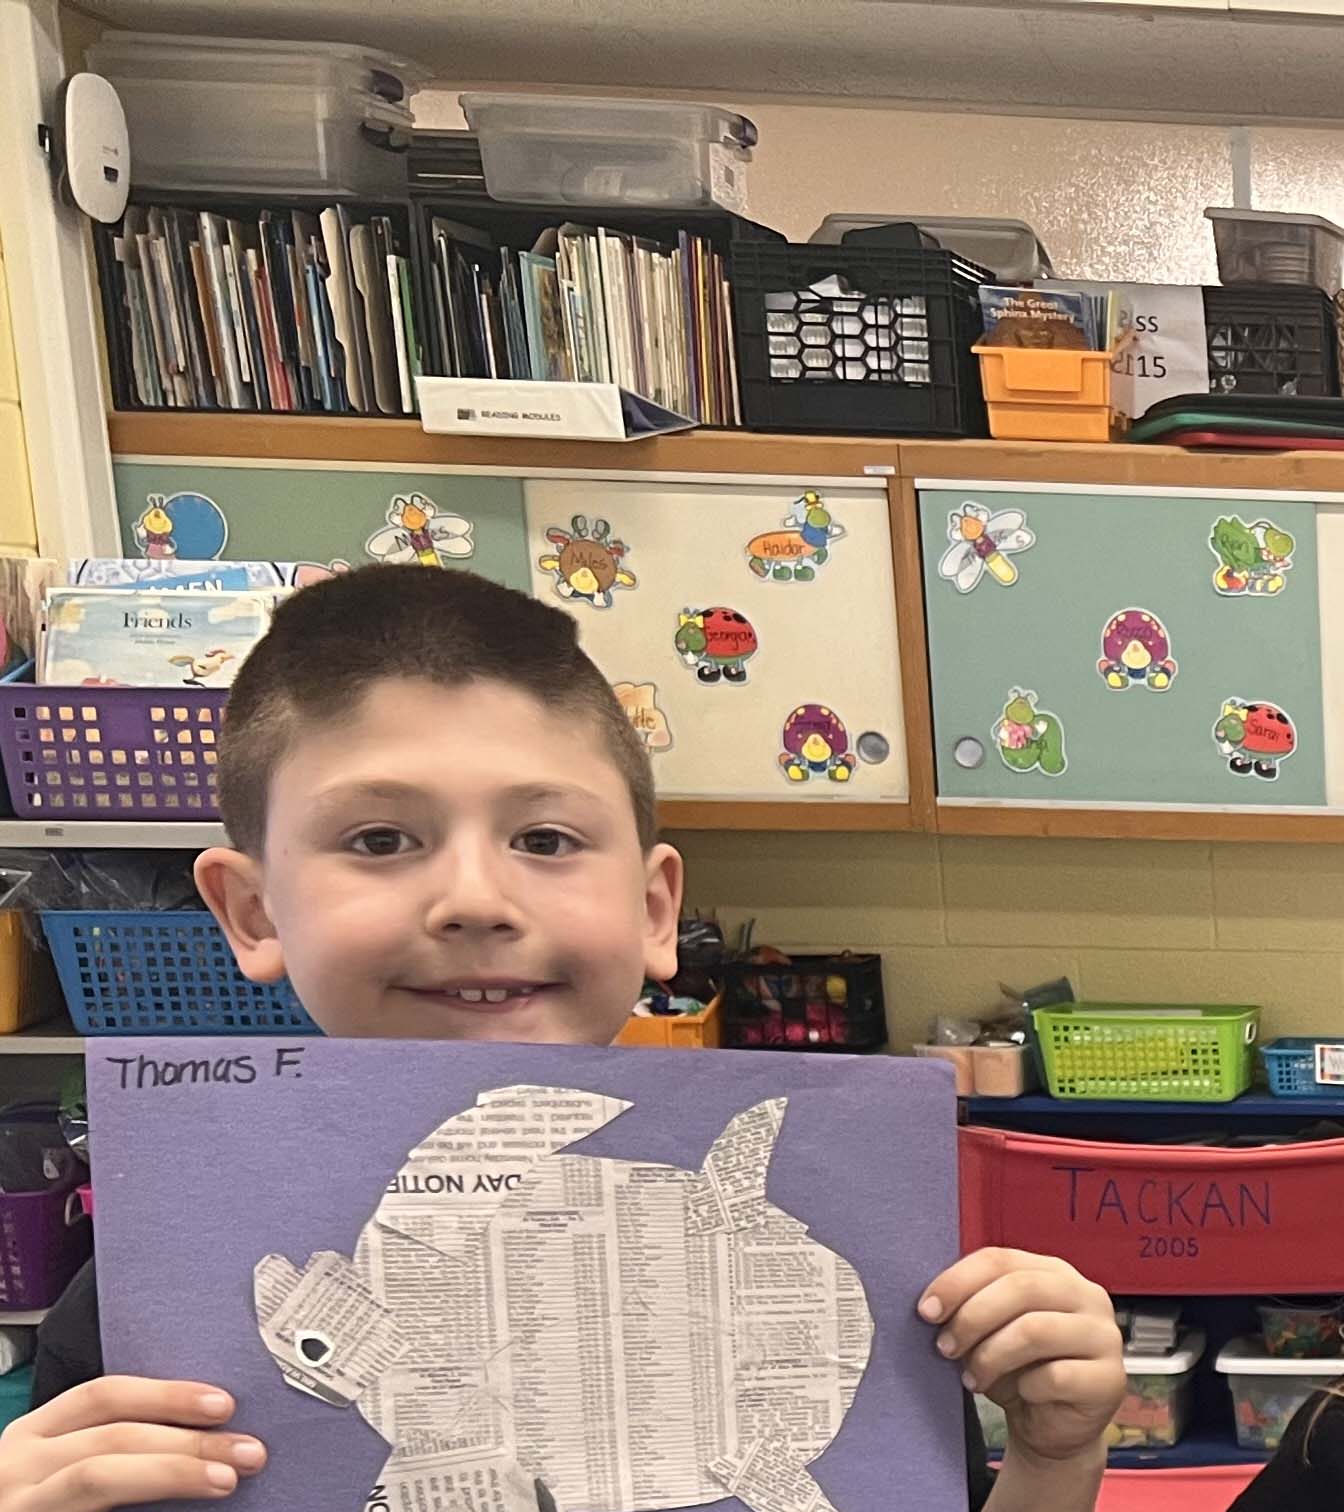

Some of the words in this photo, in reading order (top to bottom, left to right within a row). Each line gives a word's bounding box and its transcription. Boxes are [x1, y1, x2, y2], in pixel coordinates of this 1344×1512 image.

[1003, 297, 1024, 307] The
[1027, 299, 1058, 310] Great
[990, 308, 1027, 320] Sphinx
[1029, 310, 1075, 323] Mystery
[1137, 355, 1167, 378] 15
[123, 612, 193, 630] Friends
[107, 1053, 258, 1090] Thomas
[271, 1047, 305, 1079] F.
[1050, 1166, 1272, 1229] TACKAN
[1138, 1234, 1199, 1261] 2005
